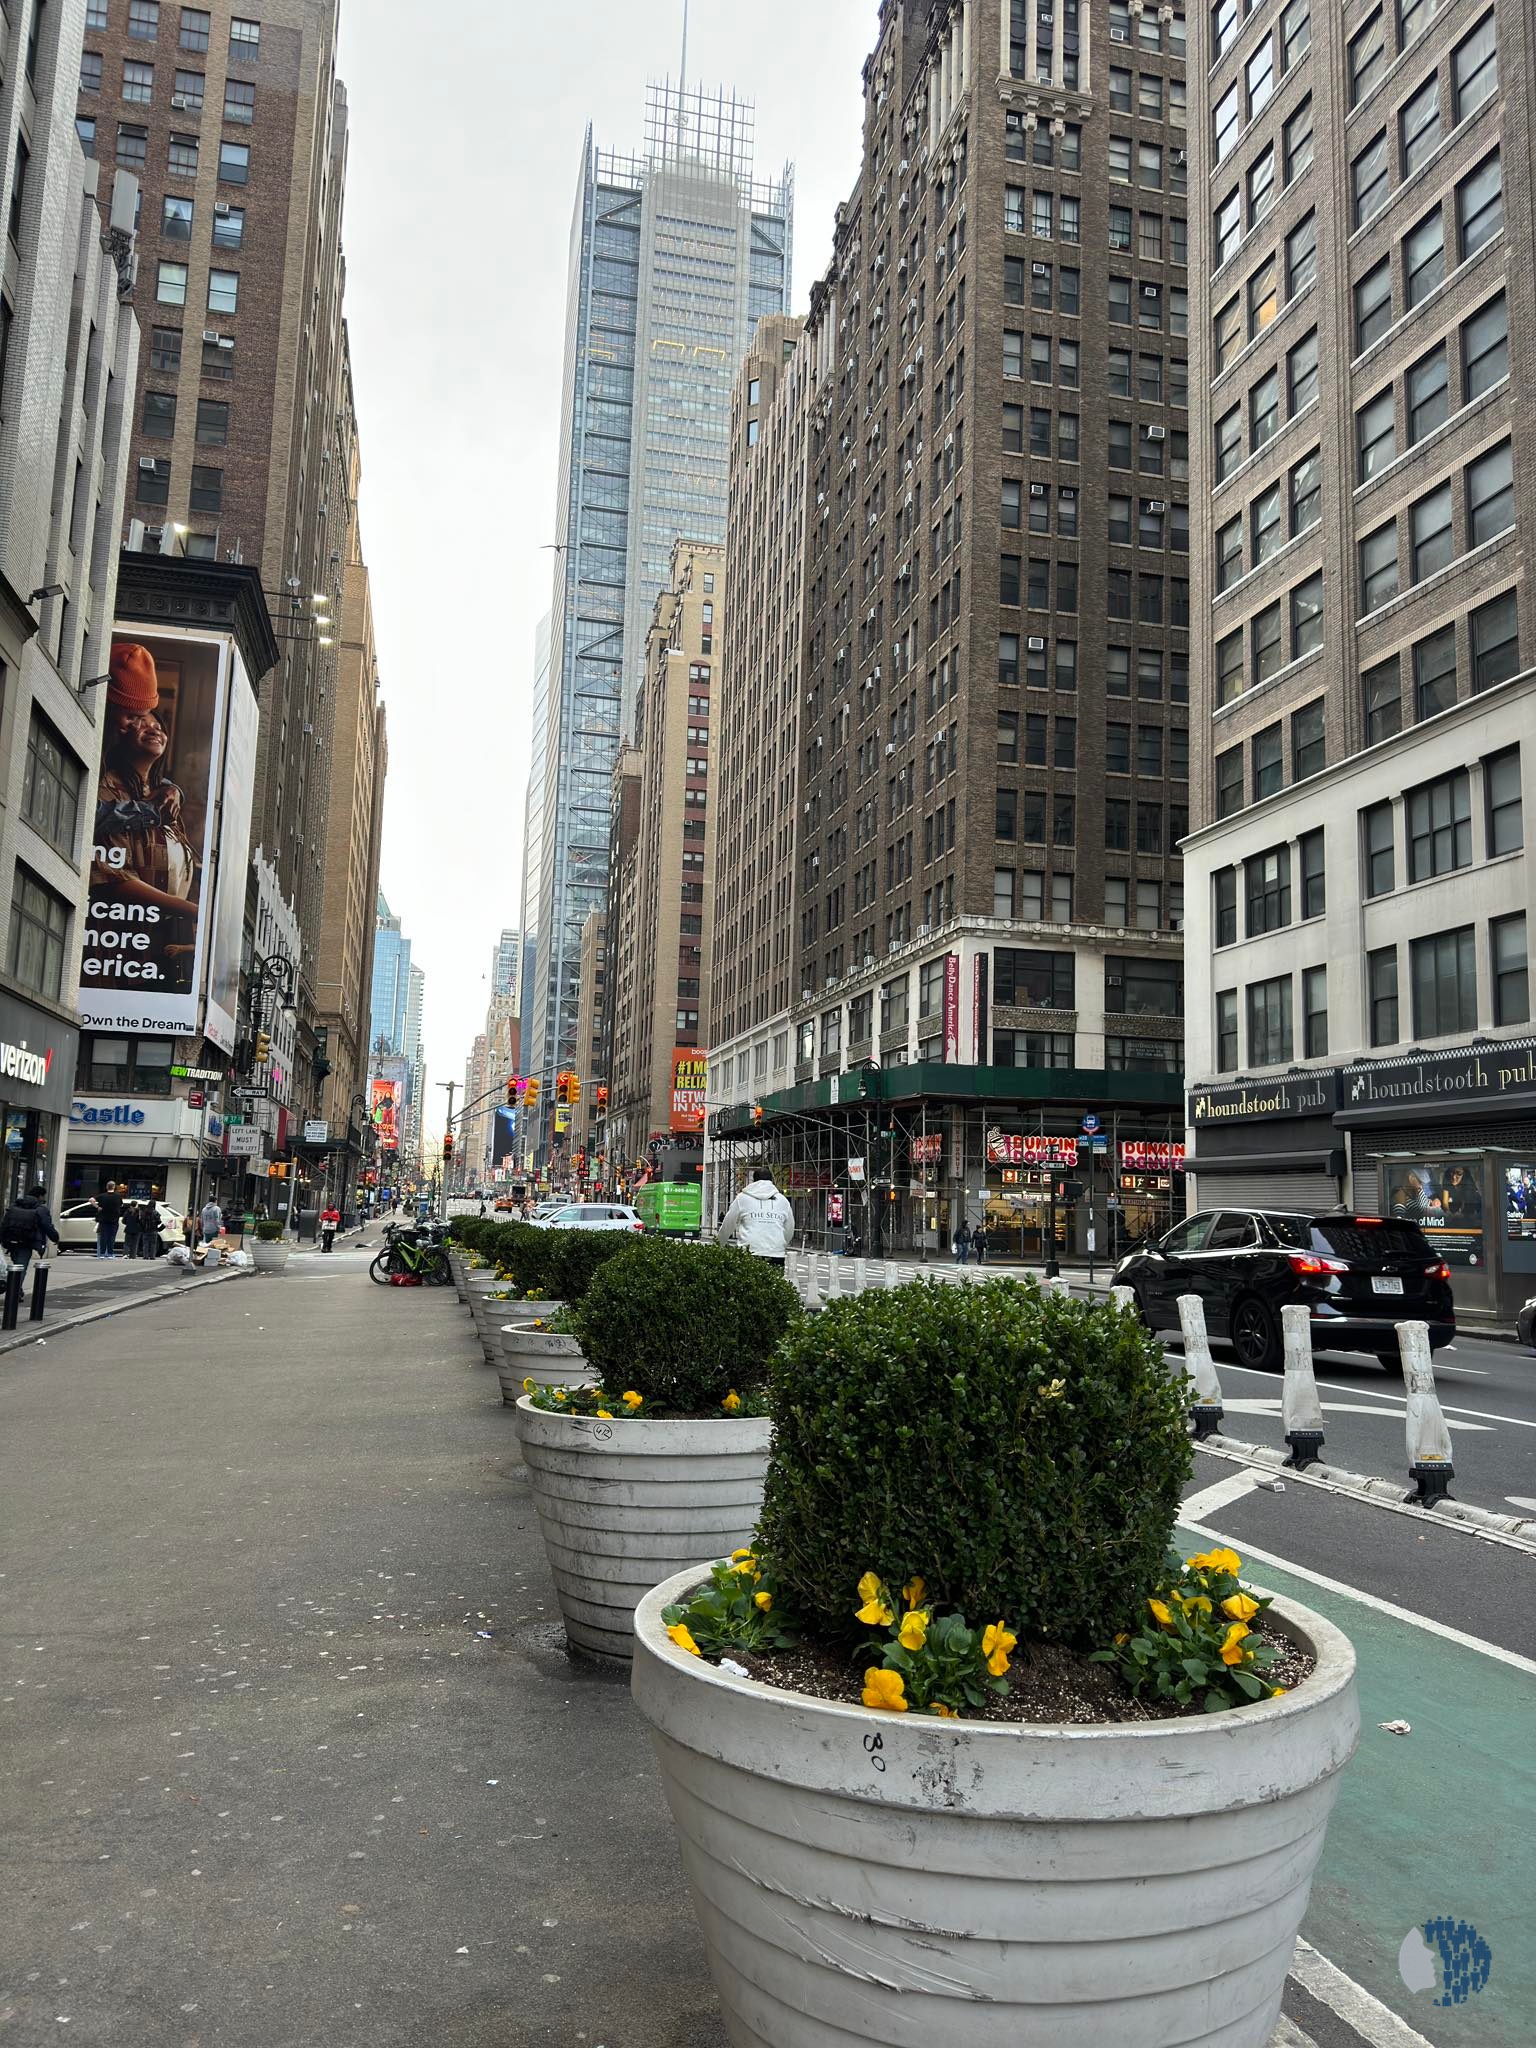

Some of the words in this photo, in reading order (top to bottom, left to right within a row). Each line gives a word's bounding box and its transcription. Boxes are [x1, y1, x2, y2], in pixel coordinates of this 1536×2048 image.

[83, 953, 165, 980] erica.
[947, 956, 957, 1001] BellyDance
[82, 1014, 112, 1026] Own
[116, 1016, 139, 1028] the
[142, 1018, 186, 1031] Dream
[1, 1041, 46, 1086] verizon
[677, 1060, 691, 1075] #1
[1368, 1058, 1489, 1100] houndstooth
[1498, 1051, 1536, 1091] pub
[673, 1103, 688, 1112] IN
[1207, 1085, 1290, 1118] houndstooth
[1297, 1080, 1326, 1112] pub
[69, 1102, 145, 1126] Castle
[1418, 1216, 1426, 1226] of
[1426, 1216, 1445, 1227] Mind
